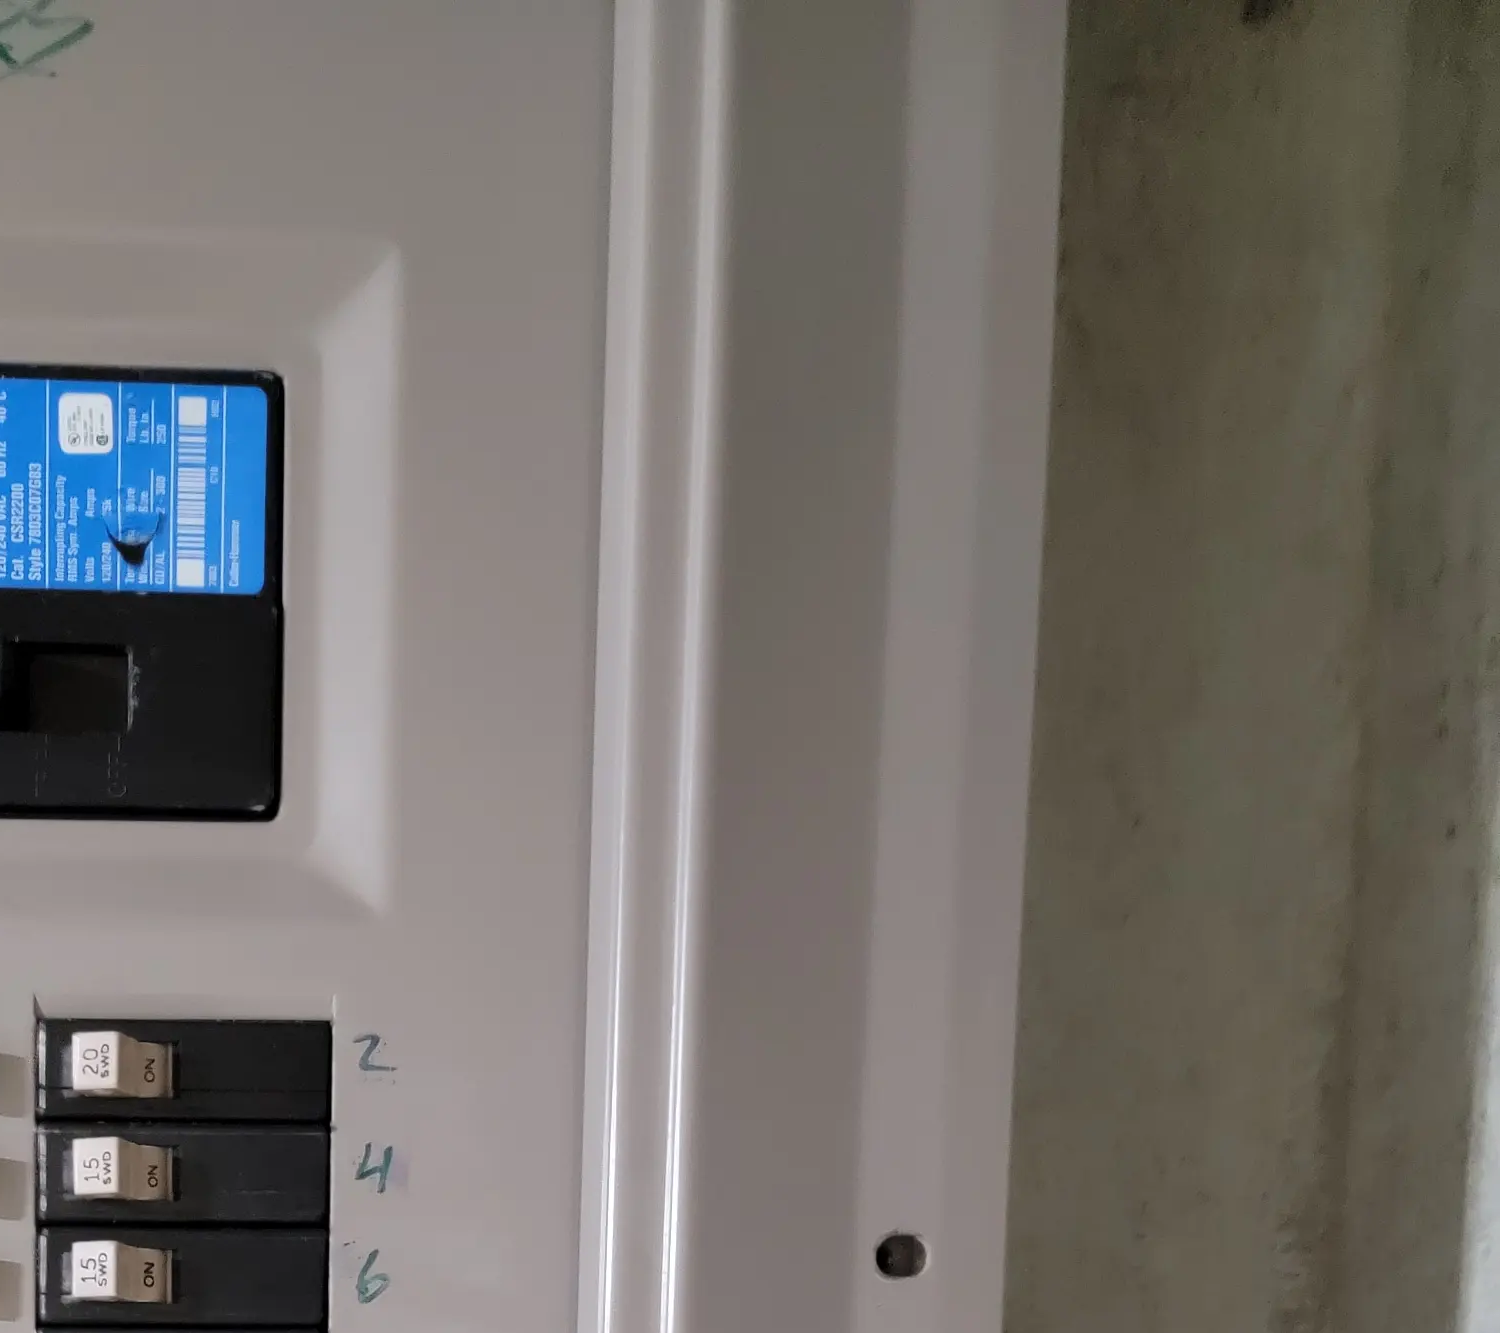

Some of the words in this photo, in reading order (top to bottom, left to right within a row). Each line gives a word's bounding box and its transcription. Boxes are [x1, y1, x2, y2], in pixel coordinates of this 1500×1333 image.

[12, 483, 24, 542] CSR2200
[55, 475, 66, 519] Capacity
[69, 496, 79, 526] Amps
[86, 488, 96, 517] Amps
[29, 548, 43, 580] Style
[55, 522, 66, 581] Interrupting
[12, 556, 24, 580] Cat.
[68, 558, 77, 582] RMS
[85, 557, 94, 583] Volts
[353, 1033, 397, 1072] 2
[355, 1143, 393, 1193] 4
[81, 1257, 97, 1285] 15
[98, 1252, 108, 1287] SWD
[143, 1261, 156, 1288] ON
[357, 1249, 390, 1304] 6
